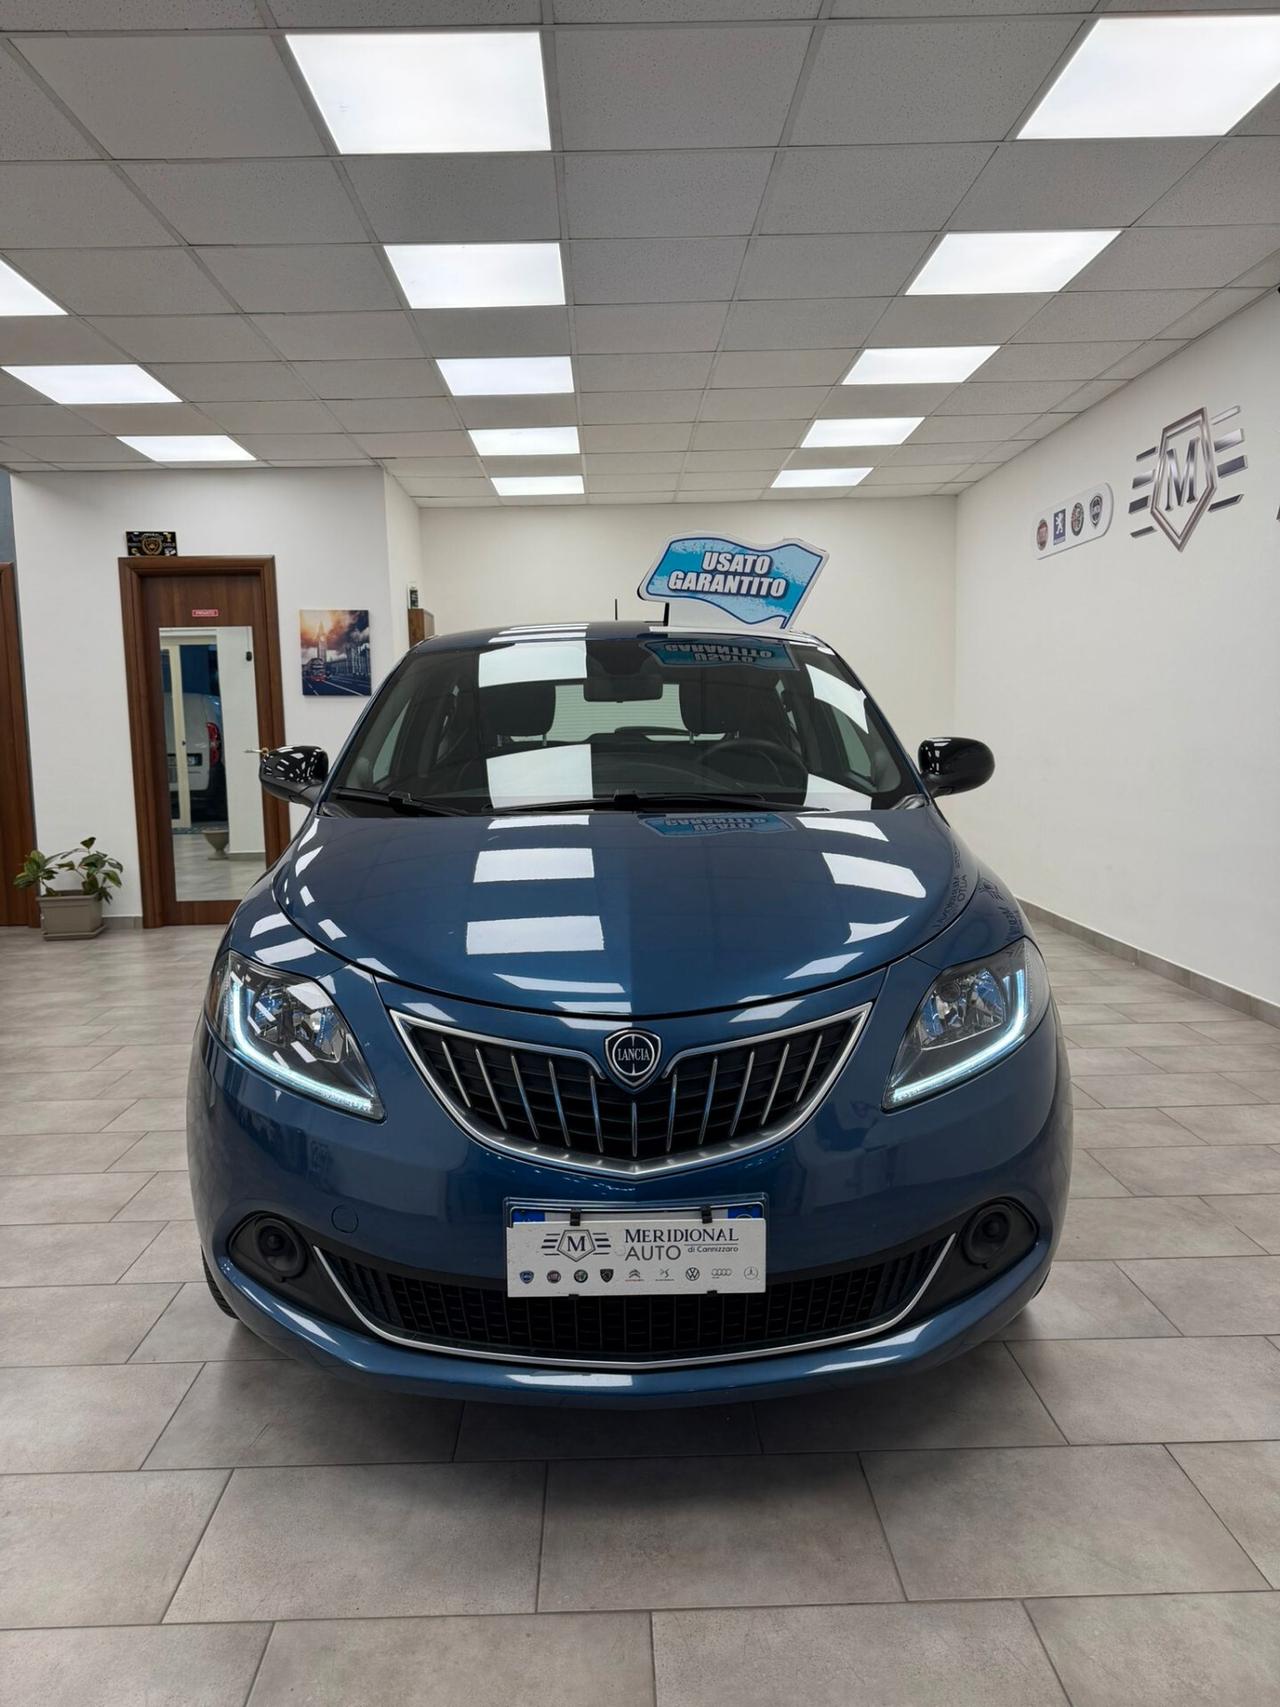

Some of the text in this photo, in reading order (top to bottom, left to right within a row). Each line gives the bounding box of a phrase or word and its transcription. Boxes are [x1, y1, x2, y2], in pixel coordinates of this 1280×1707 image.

[1165, 437, 1200, 511] M
[702, 551, 771, 575] USATO
[668, 570, 786, 598] GARANTITO
[617, 1048, 650, 1061] LANCIA
[567, 1235, 586, 1252] M
[625, 1228, 740, 1243] MERIDIONAL
[624, 1245, 682, 1261] AUTO
